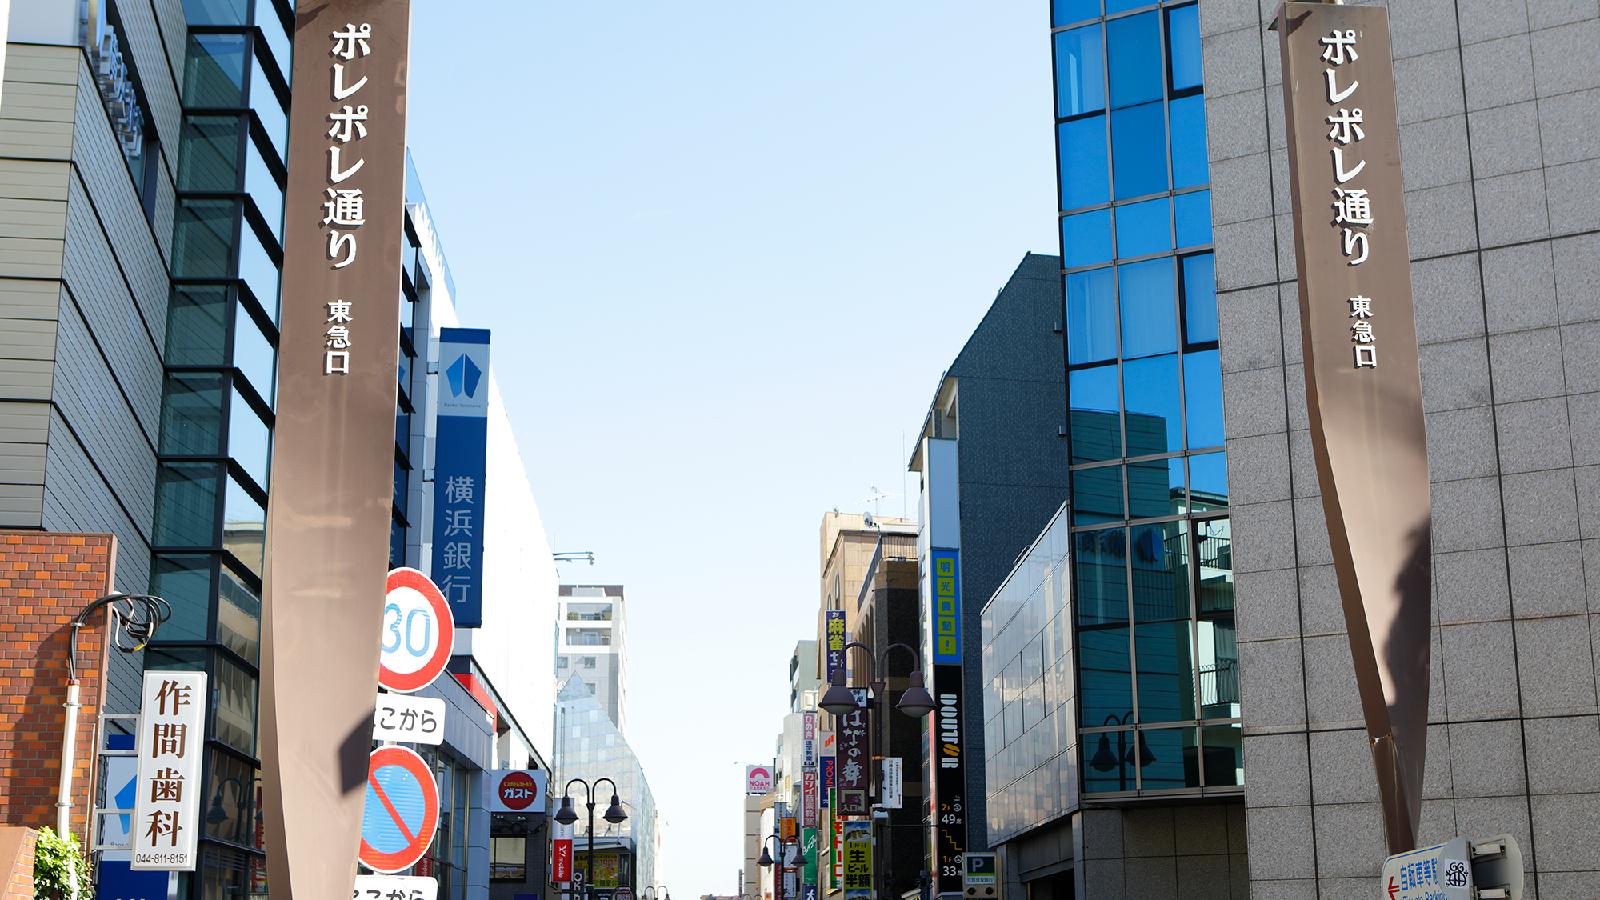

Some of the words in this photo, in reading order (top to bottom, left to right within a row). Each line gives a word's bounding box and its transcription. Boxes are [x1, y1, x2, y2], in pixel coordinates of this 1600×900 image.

[321, 23, 372, 268] ポレポレ通り
[1320, 29, 1374, 266] ポレポレ通り
[1349, 295, 1377, 368] 東急口
[325, 300, 354, 374] 東急口
[441, 476, 474, 603] 横浜銀行
[382, 603, 431, 657] 30
[374, 706, 438, 733] こから
[940, 694, 960, 768] DOUTOR
[145, 679, 192, 847] 作間歯科
[504, 787, 533, 798] ガスト
[136, 853, 188, 864] 044-811-8151
[848, 863, 868, 873] ビール
[849, 849, 865, 863] 生
[972, 858, 984, 872] P
